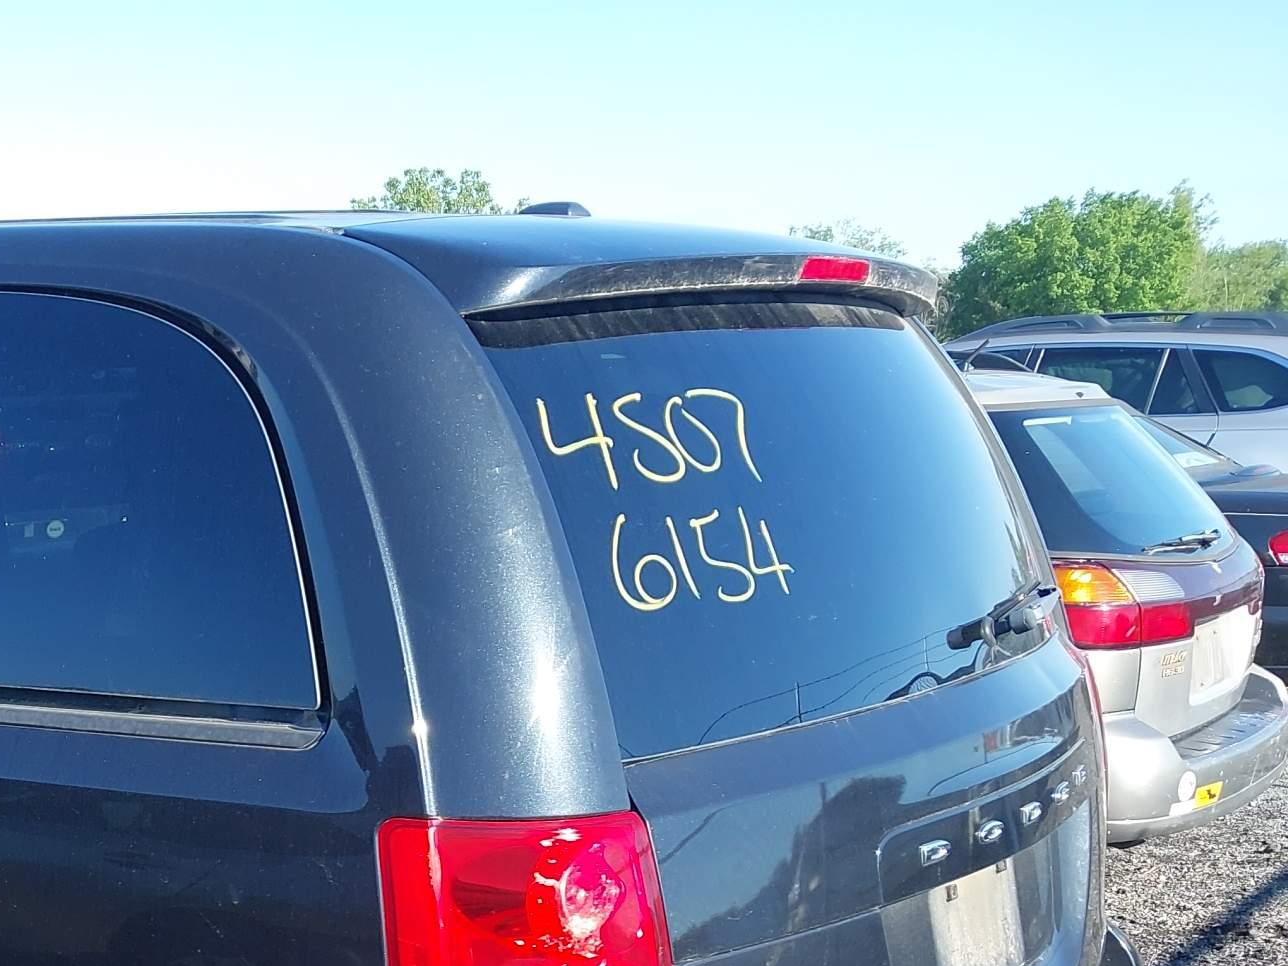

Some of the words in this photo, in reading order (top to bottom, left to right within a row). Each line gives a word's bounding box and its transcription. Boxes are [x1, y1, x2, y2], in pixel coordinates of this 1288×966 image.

[535, 387, 763, 491] 4507
[611, 505, 795, 612] 6154
[918, 763, 1088, 867] DODGE
